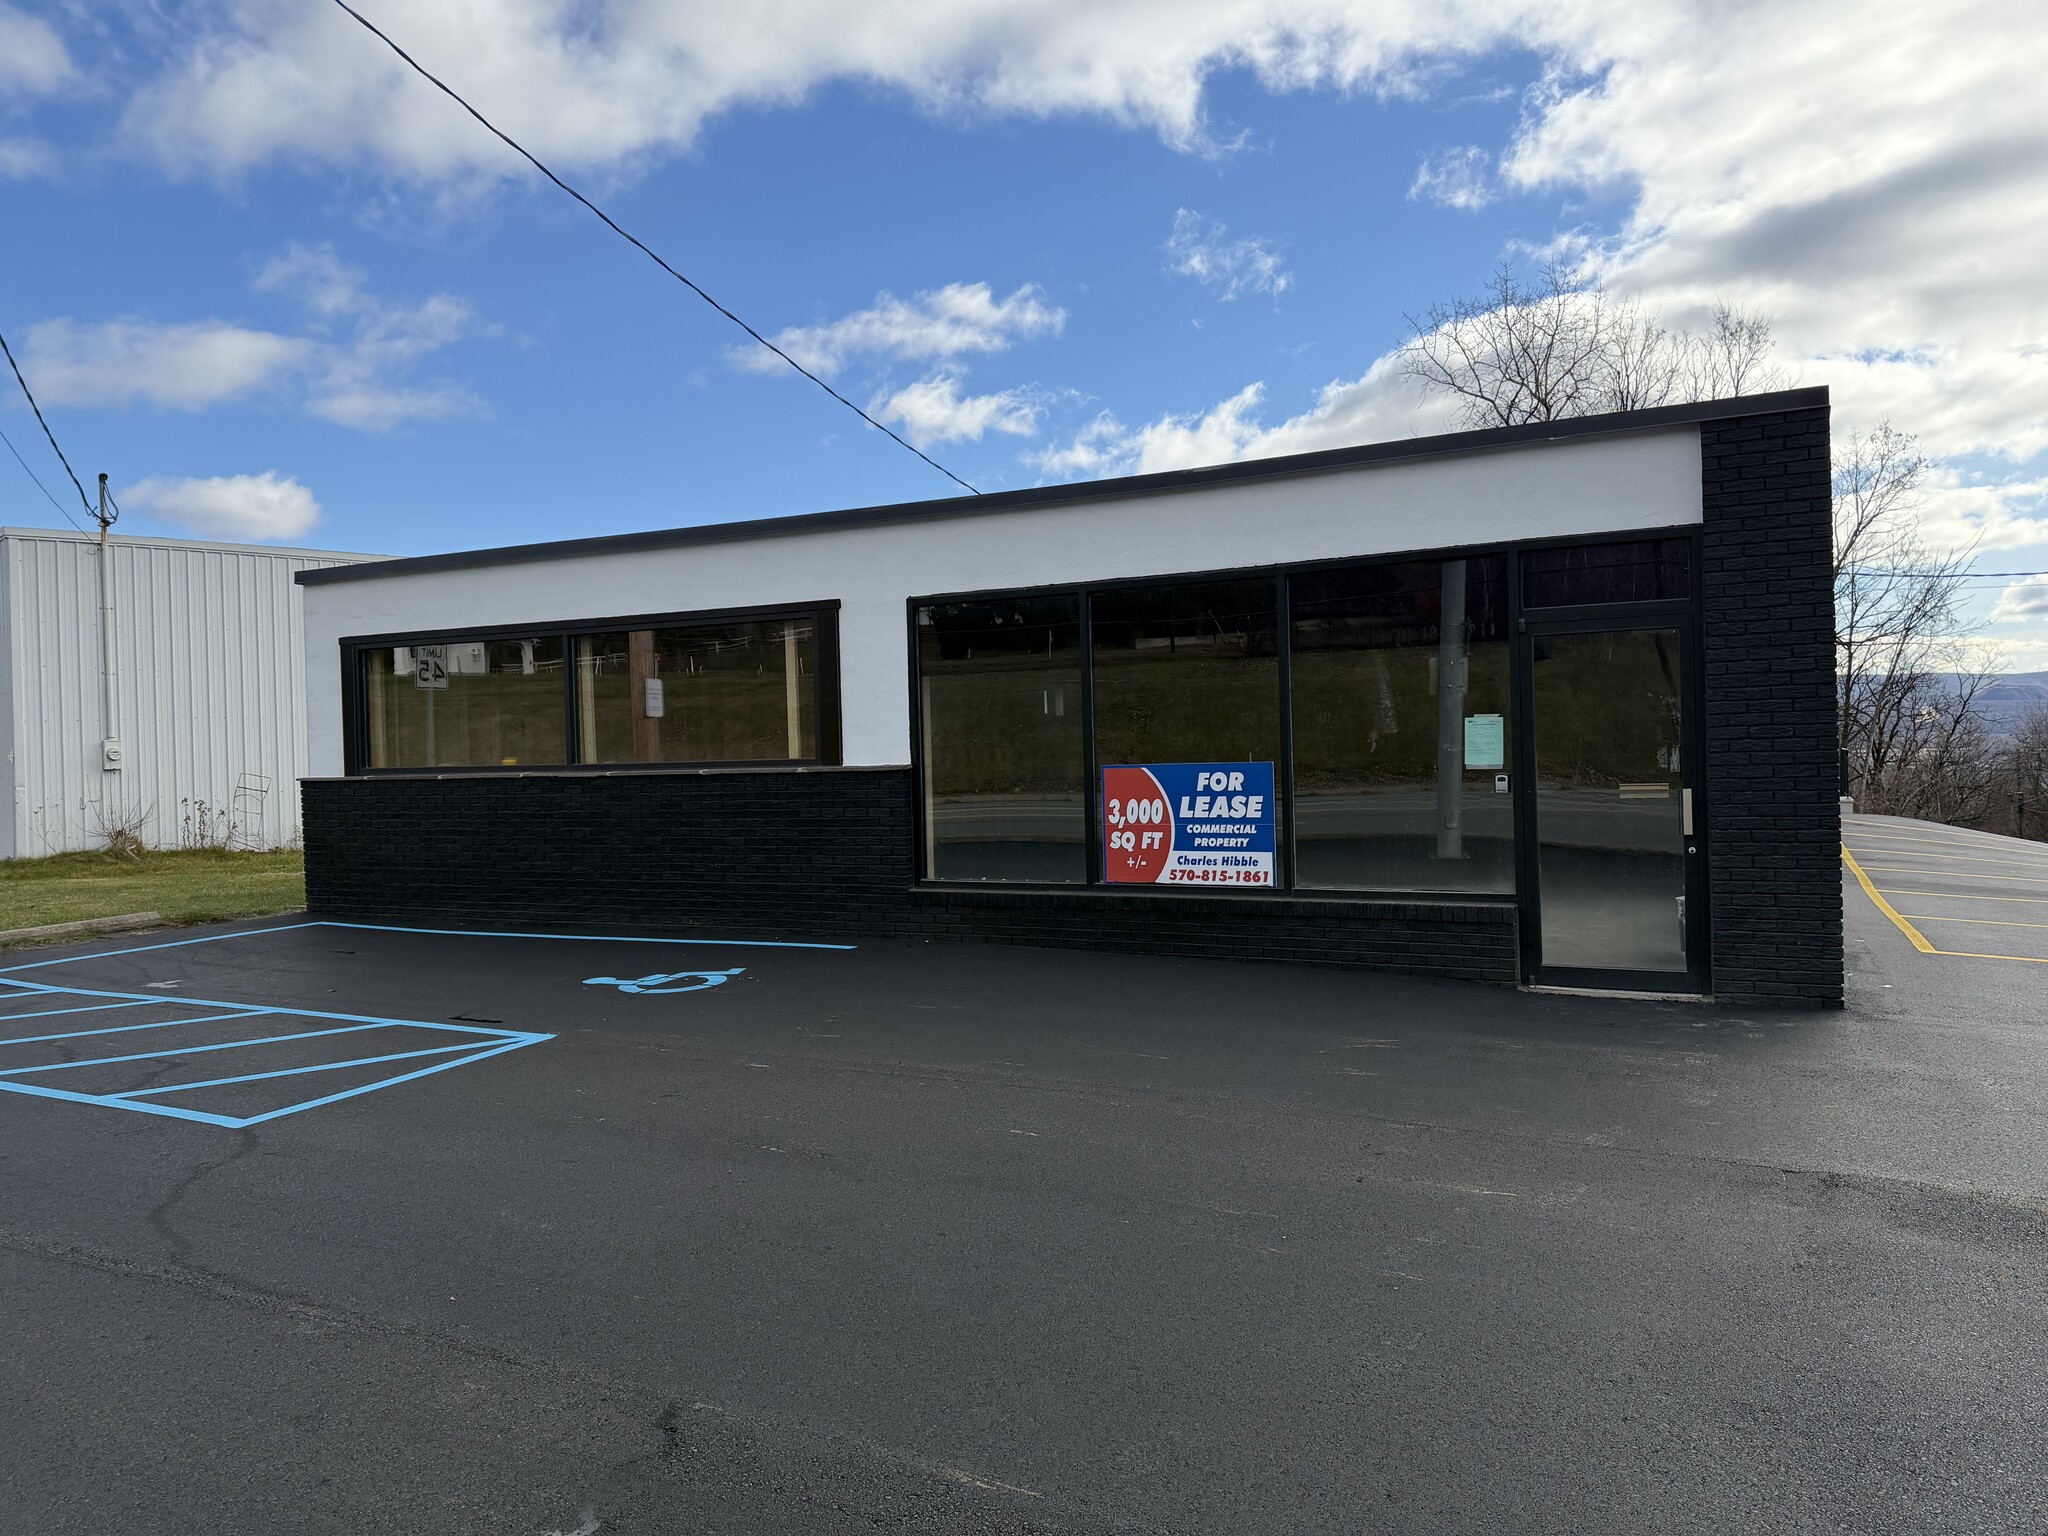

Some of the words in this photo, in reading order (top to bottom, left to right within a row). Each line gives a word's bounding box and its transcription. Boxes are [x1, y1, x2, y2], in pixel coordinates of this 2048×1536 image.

[1196, 771, 1245, 792] FOR
[1108, 798, 1164, 829] 3,000
[1179, 795, 1264, 819] LEASE
[1186, 824, 1257, 834] COMMERCIAL
[1109, 831, 1136, 852] SQ
[1141, 831, 1164, 850] FT
[1193, 837, 1250, 847] PROPERTY
[1177, 855, 1218, 867] Charles
[1221, 855, 1259, 867] Hibble
[1168, 869, 1269, 883] 570-815-1861
